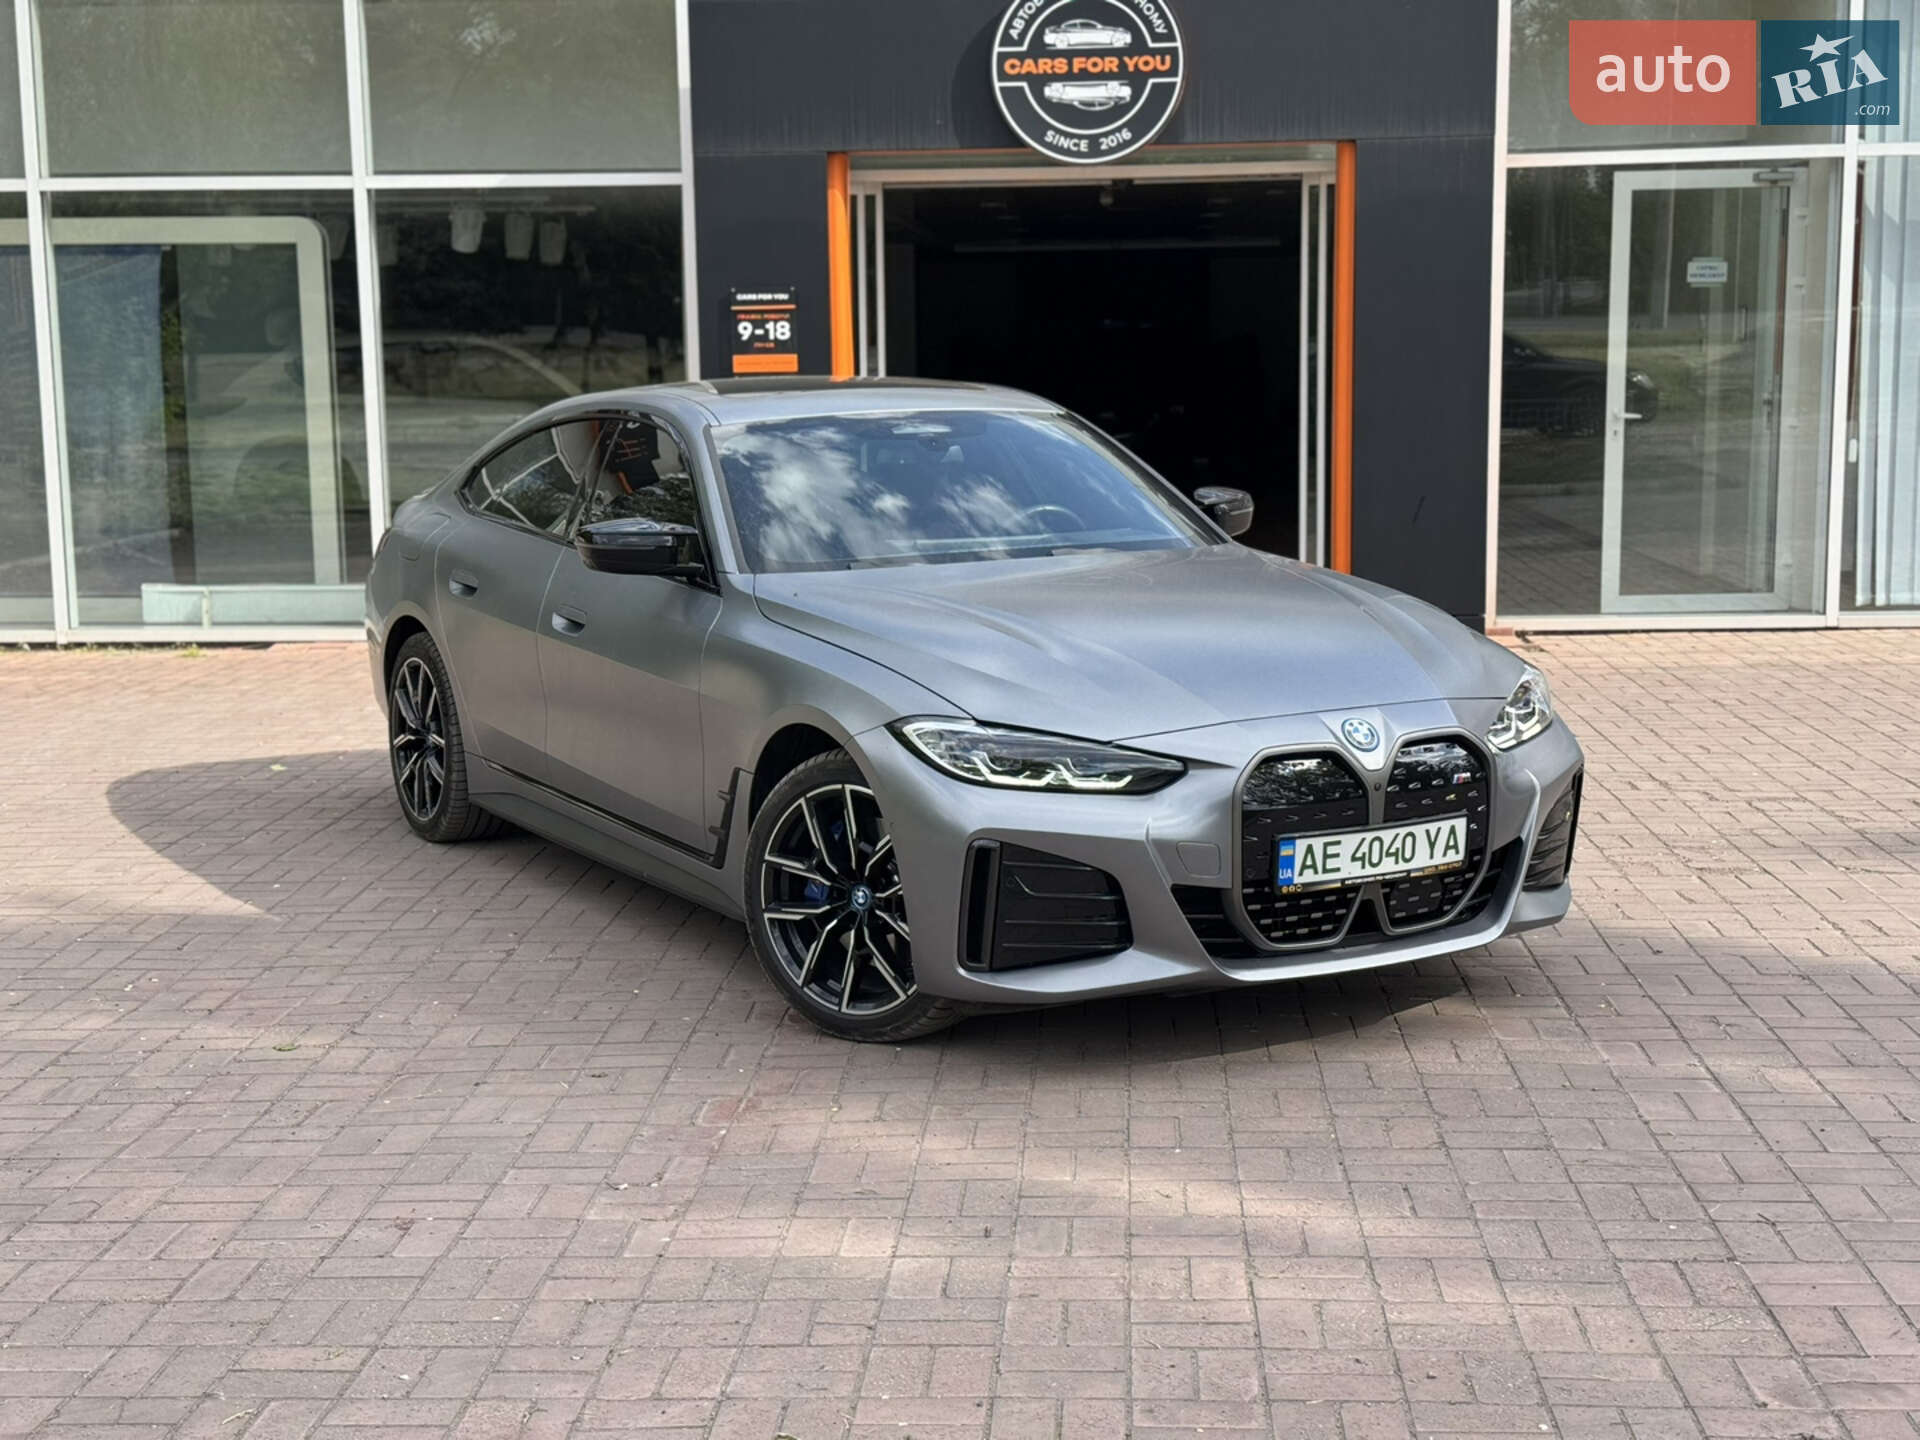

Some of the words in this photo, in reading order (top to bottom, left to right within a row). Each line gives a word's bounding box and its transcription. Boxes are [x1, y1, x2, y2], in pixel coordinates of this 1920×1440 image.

[1004, 57, 1068, 75] CARS
[1073, 56, 1119, 73] FOR
[1123, 54, 1172, 73] YOU
[1044, 130, 1089, 152] SINCE
[1099, 127, 1133, 151] 2016
[737, 320, 791, 341] 9-18
[1298, 840, 1342, 877] AE
[1350, 830, 1417, 870] 4040
[1425, 823, 1461, 860] YA
[1279, 868, 1293, 880] UA
